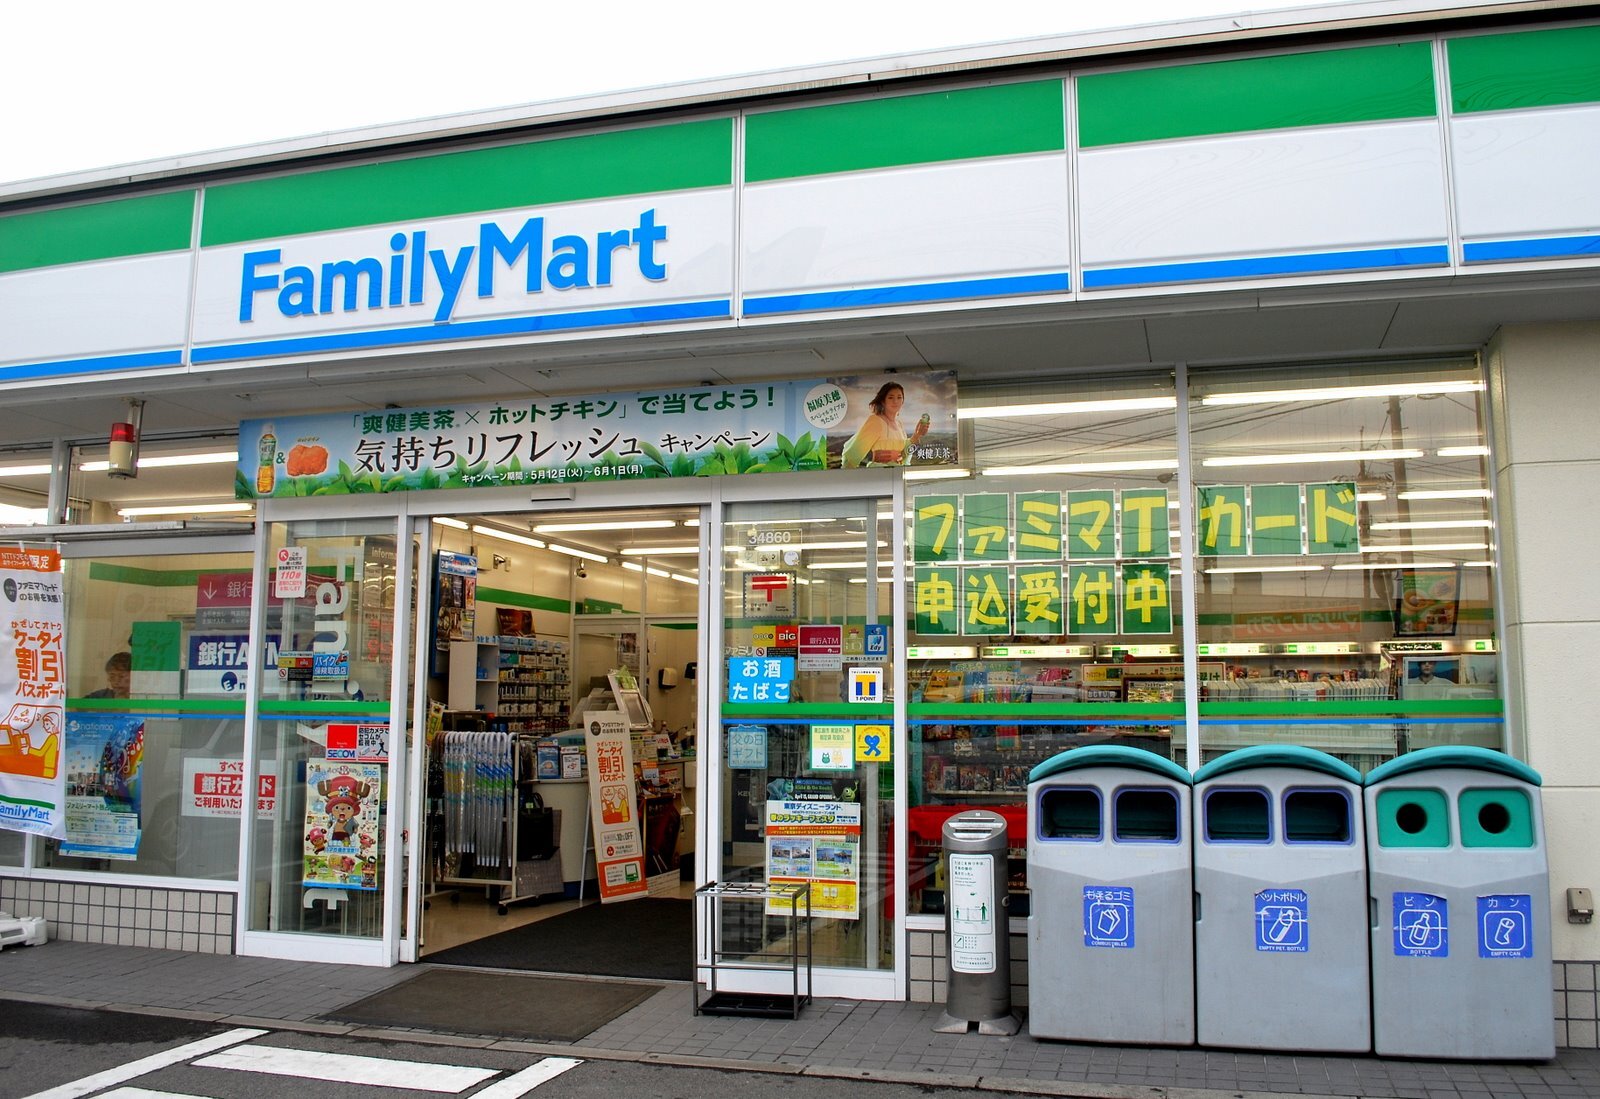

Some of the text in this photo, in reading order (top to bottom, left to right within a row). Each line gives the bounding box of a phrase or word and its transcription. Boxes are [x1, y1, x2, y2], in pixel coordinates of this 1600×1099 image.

[239, 208, 668, 326] FamilyMart
[354, 427, 771, 474] 気持ちリフレッシュ キャンペーン
[276, 452, 286, 464] &
[748, 531, 791, 544] 34860
[917, 568, 1168, 625] 申込受付中
[11, 619, 62, 631] かざしてオトク
[14, 629, 63, 650] ケータイ
[809, 637, 839, 645] 銀行ATM
[725, 645, 753, 656] ファミリ
[15, 647, 65, 683] 割引
[315, 656, 336, 667] バイク
[742, 660, 781, 678] お酒
[16, 681, 65, 700] パスポート
[733, 682, 788, 700] たばこ
[732, 734, 763, 746] 父の日
[328, 749, 355, 758] SECOM
[597, 746, 623, 756] ケータイ
[732, 748, 763, 759] ギフト
[598, 756, 624, 773] 割引
[600, 773, 626, 782] パスポート
[202, 775, 272, 795] 銀行カド
[0, 802, 49, 820] amilyMart
[784, 803, 841, 811] 東京ディズニーランド
[1255, 892, 1307, 902] ペットボトル
[1404, 896, 1435, 907] ビン
[1488, 899, 1519, 908] カン
